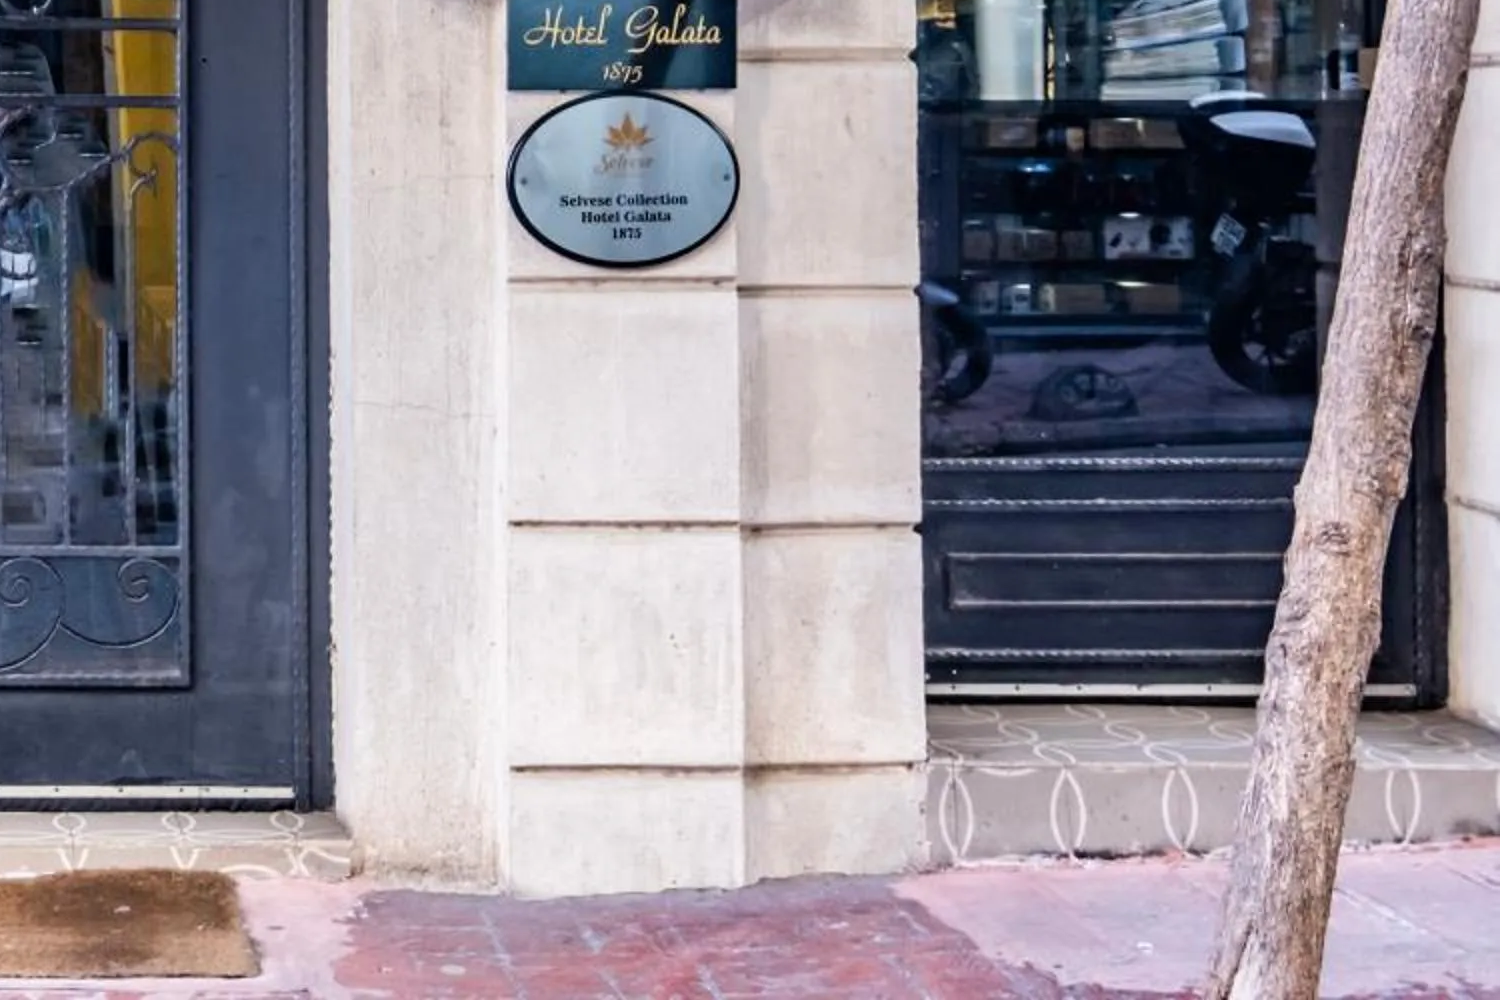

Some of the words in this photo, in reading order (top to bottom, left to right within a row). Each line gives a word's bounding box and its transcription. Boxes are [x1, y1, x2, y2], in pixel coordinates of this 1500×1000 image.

[524, 4, 612, 48] Hotel
[625, 4, 721, 53] Galata
[603, 61, 643, 83] 1875
[560, 195, 612, 207] Selvese
[616, 193, 688, 206] Collection
[581, 211, 620, 223] Hotel
[623, 210, 671, 222] Galata
[613, 227, 642, 239] 1875
